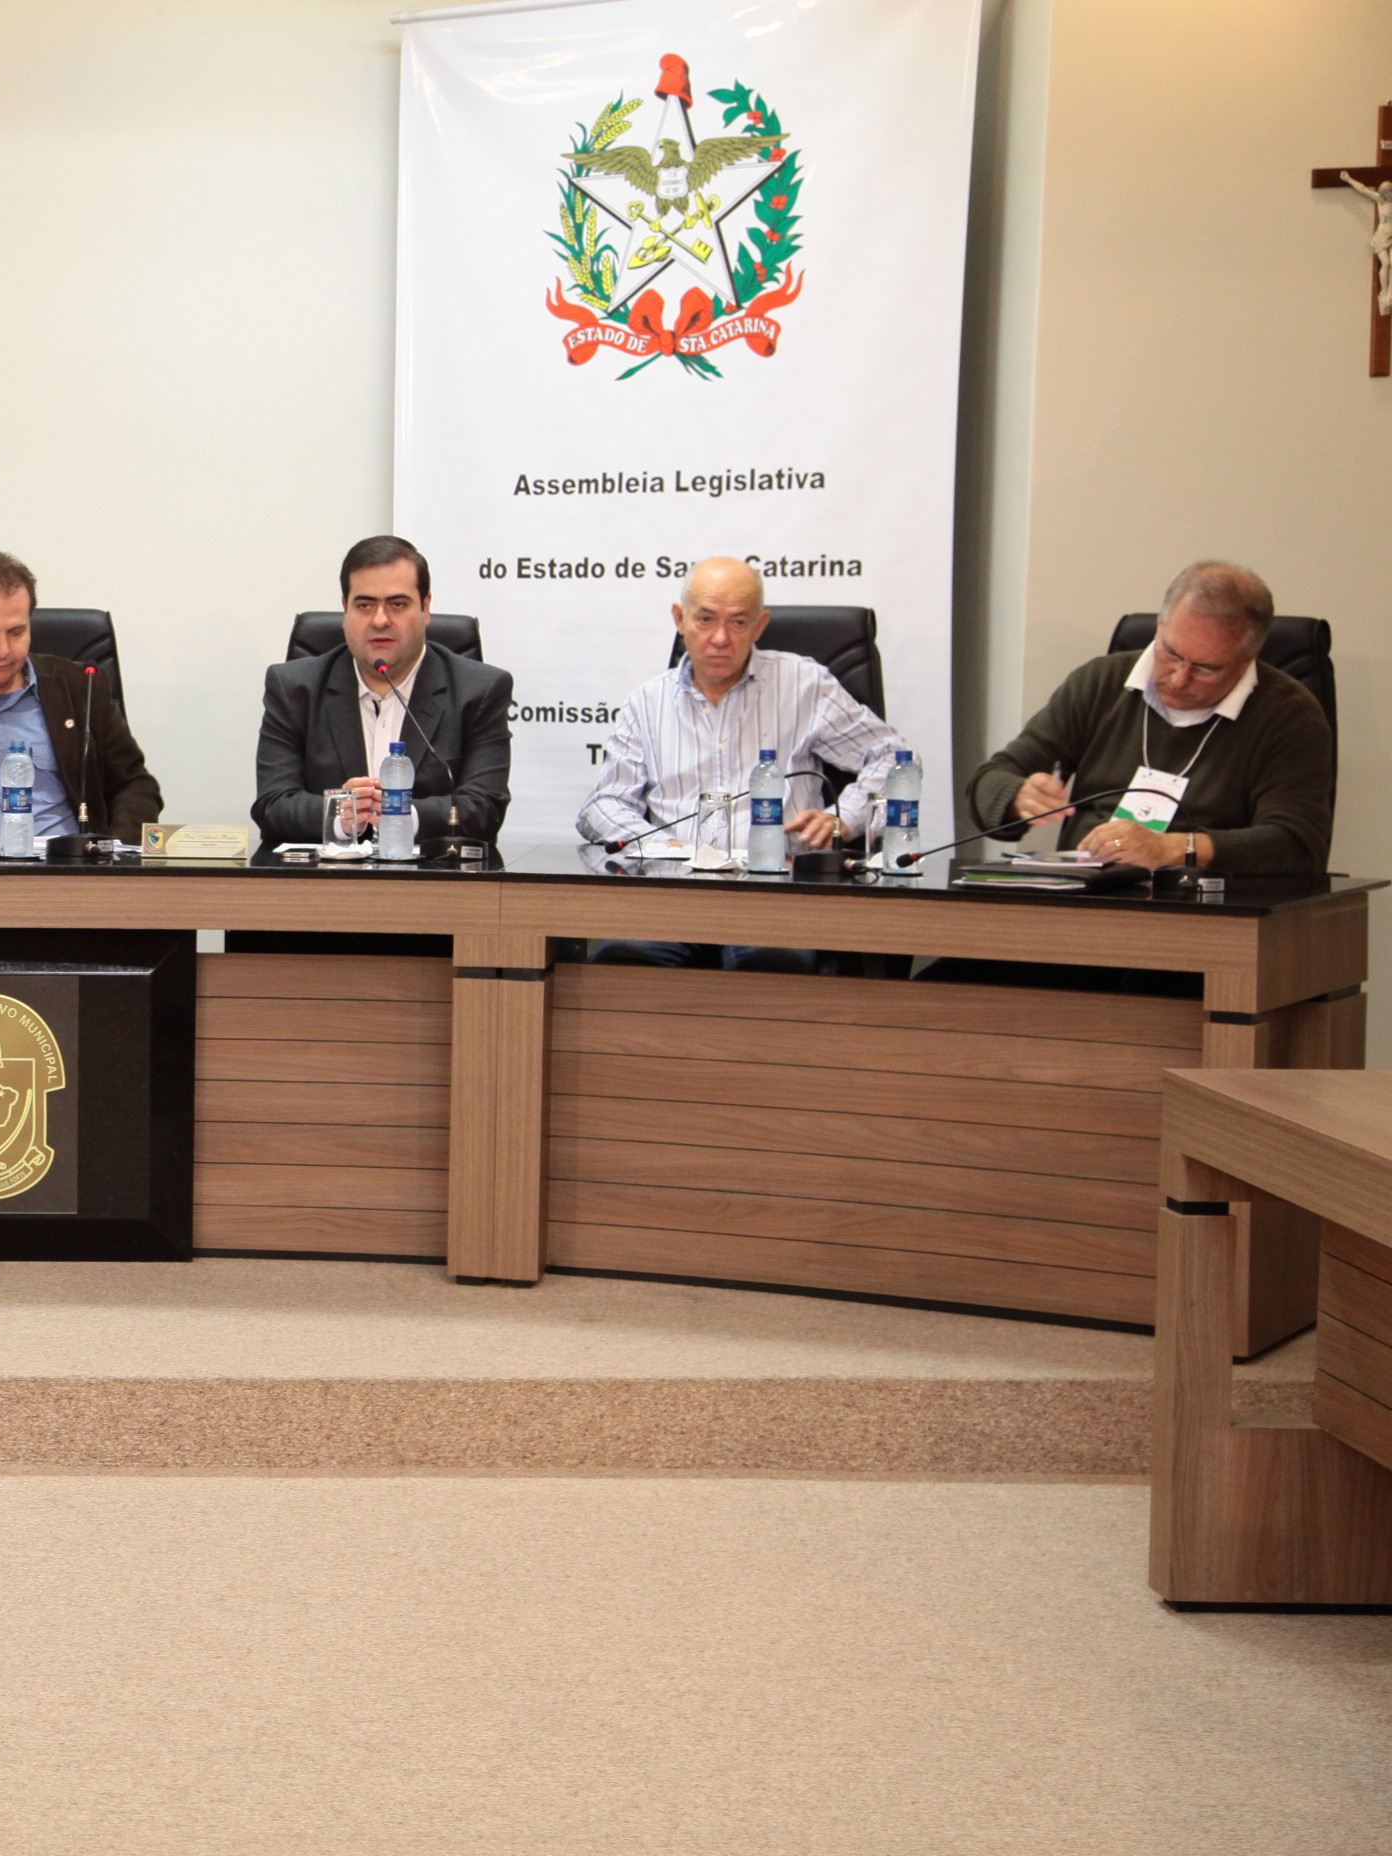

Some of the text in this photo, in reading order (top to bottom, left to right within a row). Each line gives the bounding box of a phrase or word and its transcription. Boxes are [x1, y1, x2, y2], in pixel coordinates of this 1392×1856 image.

[567, 327, 625, 349] ESTADO
[626, 336, 648, 353] DE
[710, 318, 776, 345] CATARINA
[514, 467, 826, 498] Assembleia Legislativa
[478, 558, 508, 580] do
[516, 557, 606, 579] Estado
[614, 557, 646, 579] de
[19, 1014, 58, 1084] MUNICIPAL
